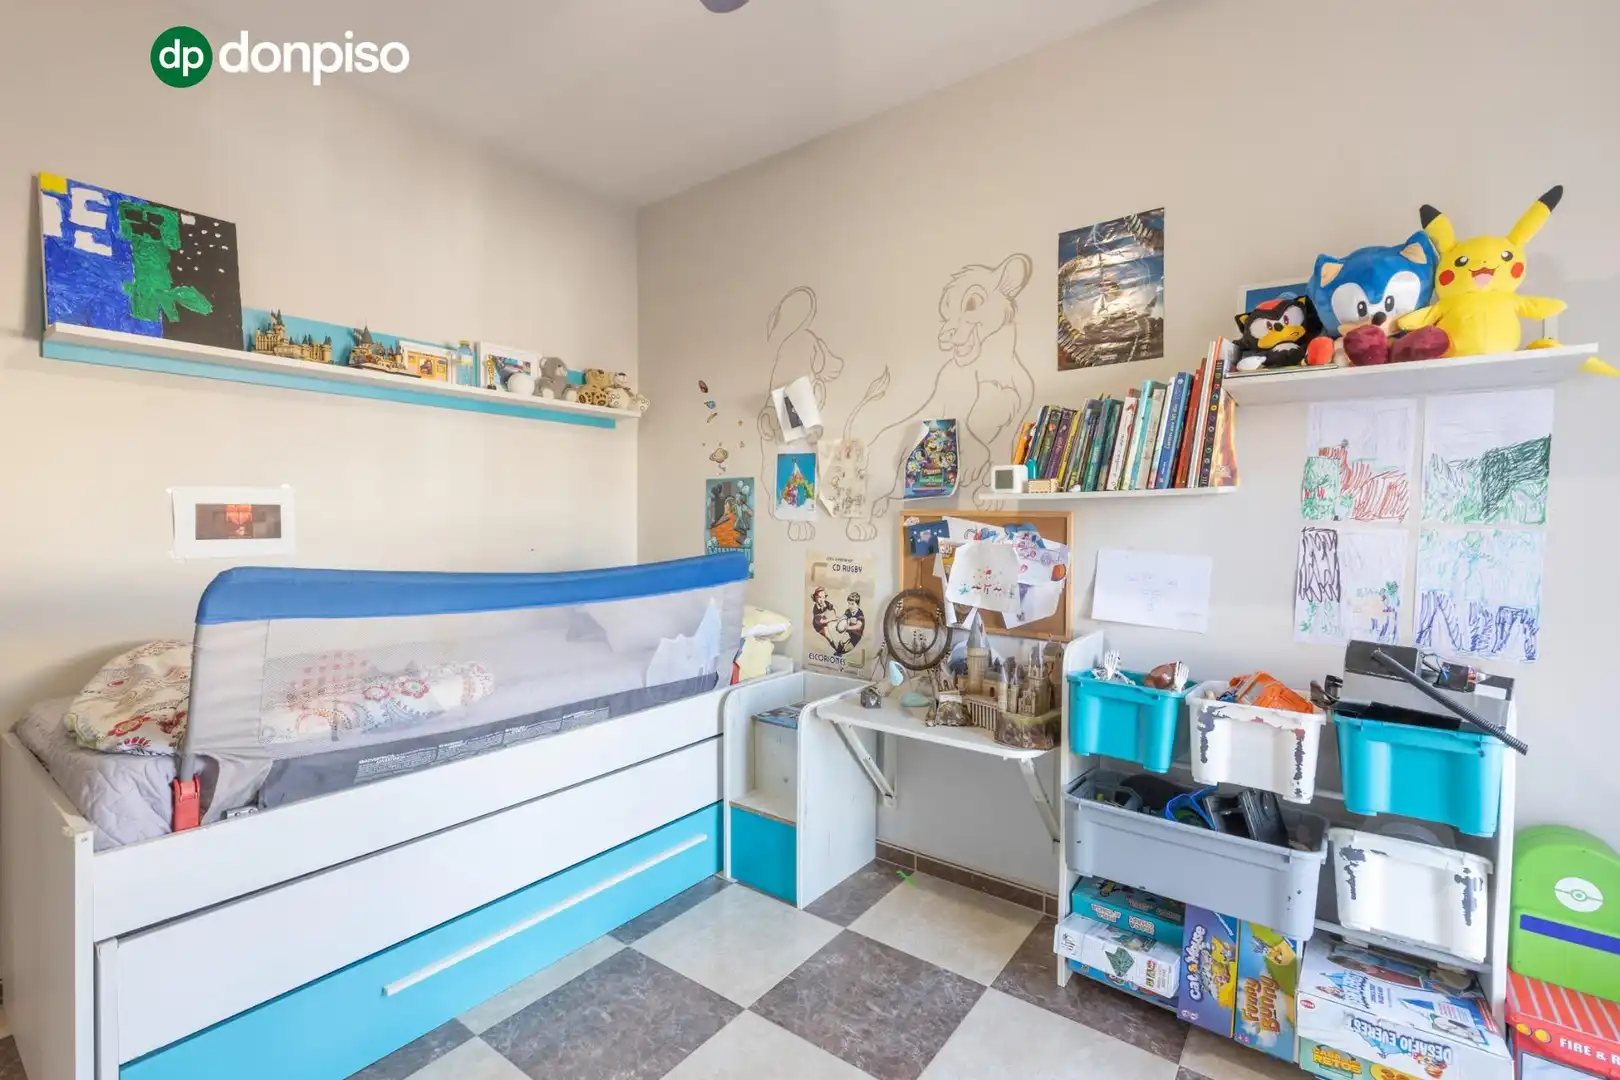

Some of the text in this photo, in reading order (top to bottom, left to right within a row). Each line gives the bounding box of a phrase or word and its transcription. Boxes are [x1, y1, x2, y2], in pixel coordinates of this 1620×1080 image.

[832, 564, 862, 574] CD RUGBY
[1185, 925, 1206, 964] Mouse
[1242, 978, 1261, 1021] Funny
[1261, 976, 1280, 1032] Bunny
[1350, 1017, 1397, 1045] EVEREST
[1560, 1038, 1592, 1056] FIRE
[1596, 1051, 1606, 1061] &
